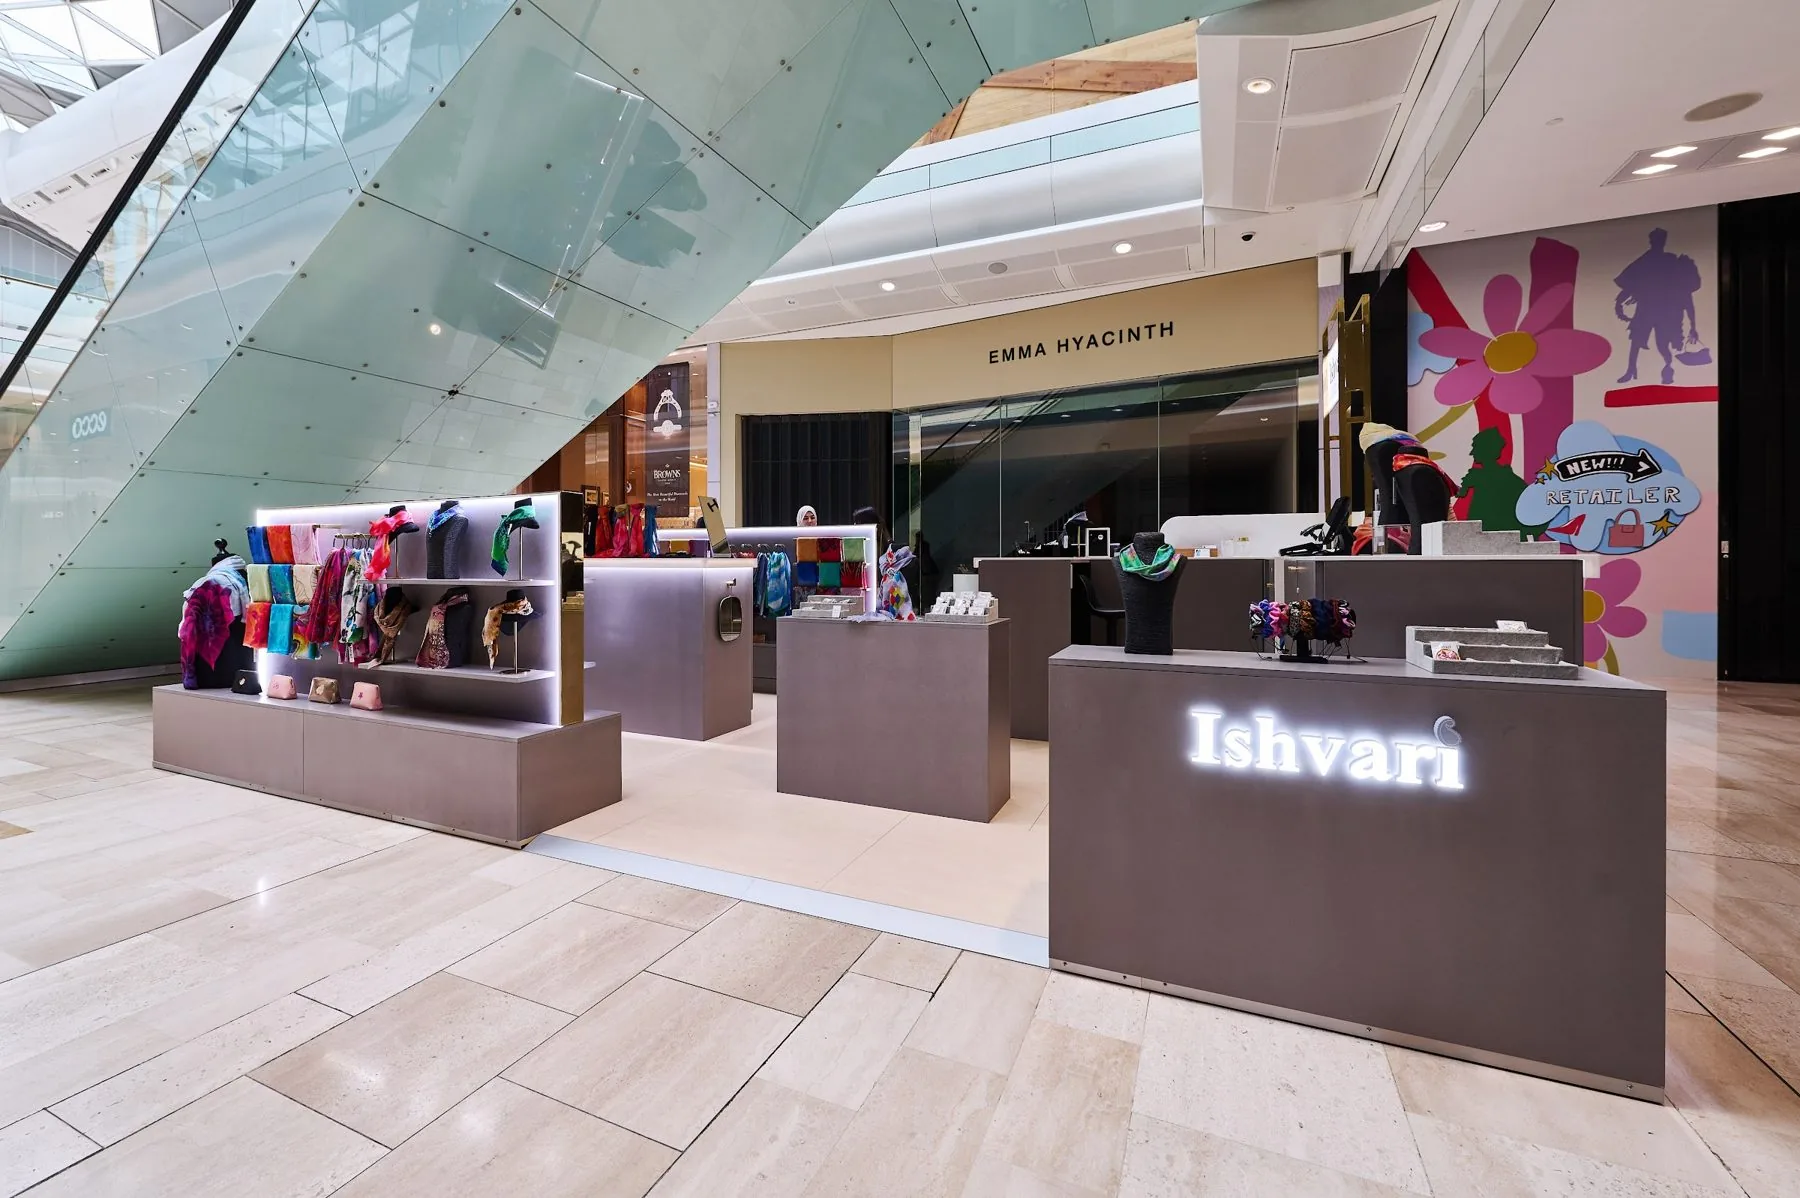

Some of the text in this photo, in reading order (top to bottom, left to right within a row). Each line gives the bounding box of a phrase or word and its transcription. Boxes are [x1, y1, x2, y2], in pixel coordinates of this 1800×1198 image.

[989, 321, 1174, 364] EMMA HYACINTH
[654, 470, 680, 479] BROWNS
[1565, 456, 1625, 475] NEW!!!
[1545, 486, 1681, 506] RETAILER
[1190, 708, 1465, 790] Ishvari
